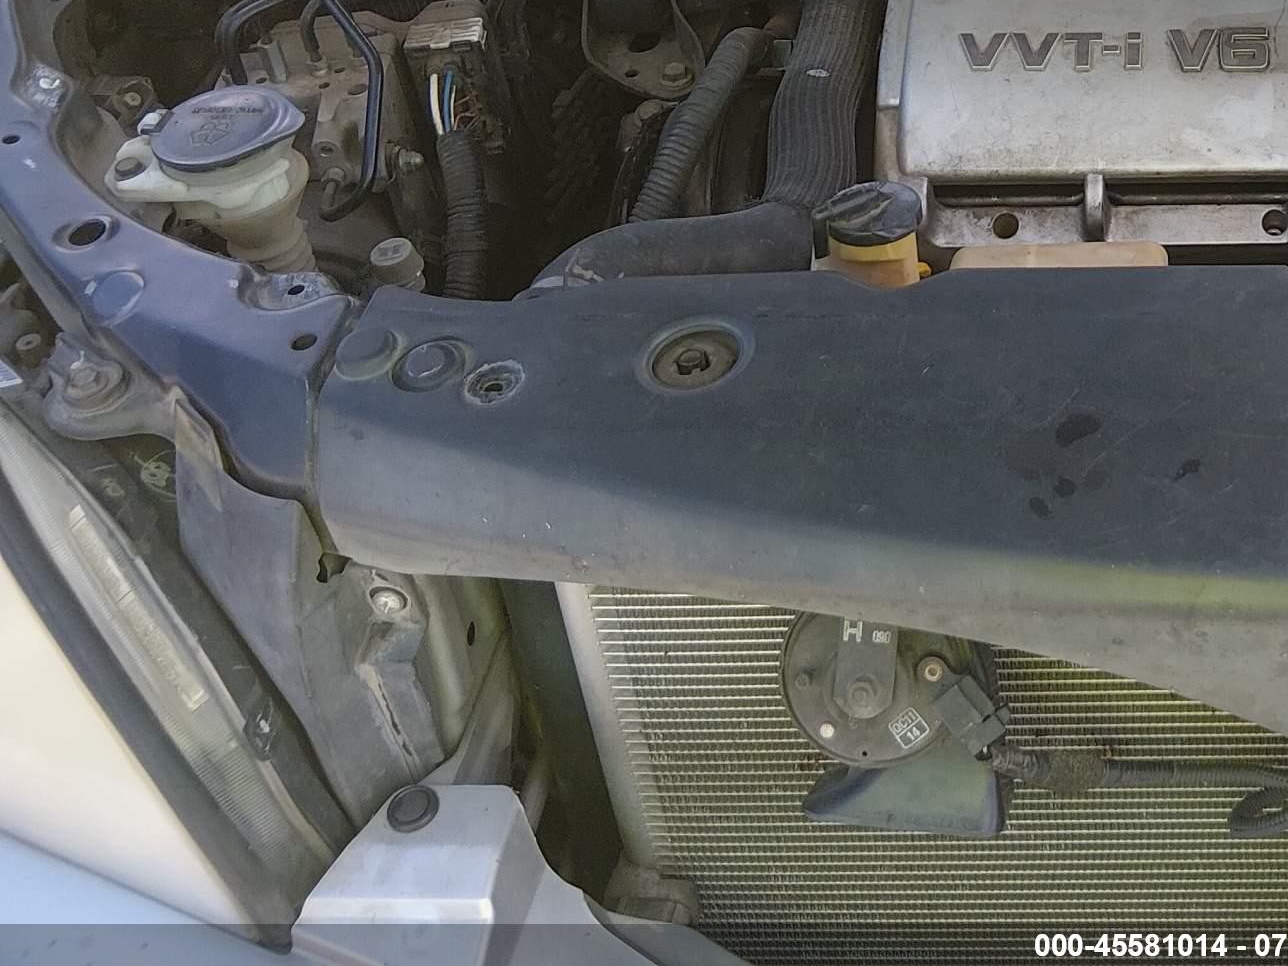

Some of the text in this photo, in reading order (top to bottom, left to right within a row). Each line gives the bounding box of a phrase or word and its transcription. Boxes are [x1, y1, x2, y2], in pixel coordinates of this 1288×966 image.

[957, 31, 1143, 72] VVT-i
[1166, 26, 1271, 73] V6
[843, 620, 863, 642] H
